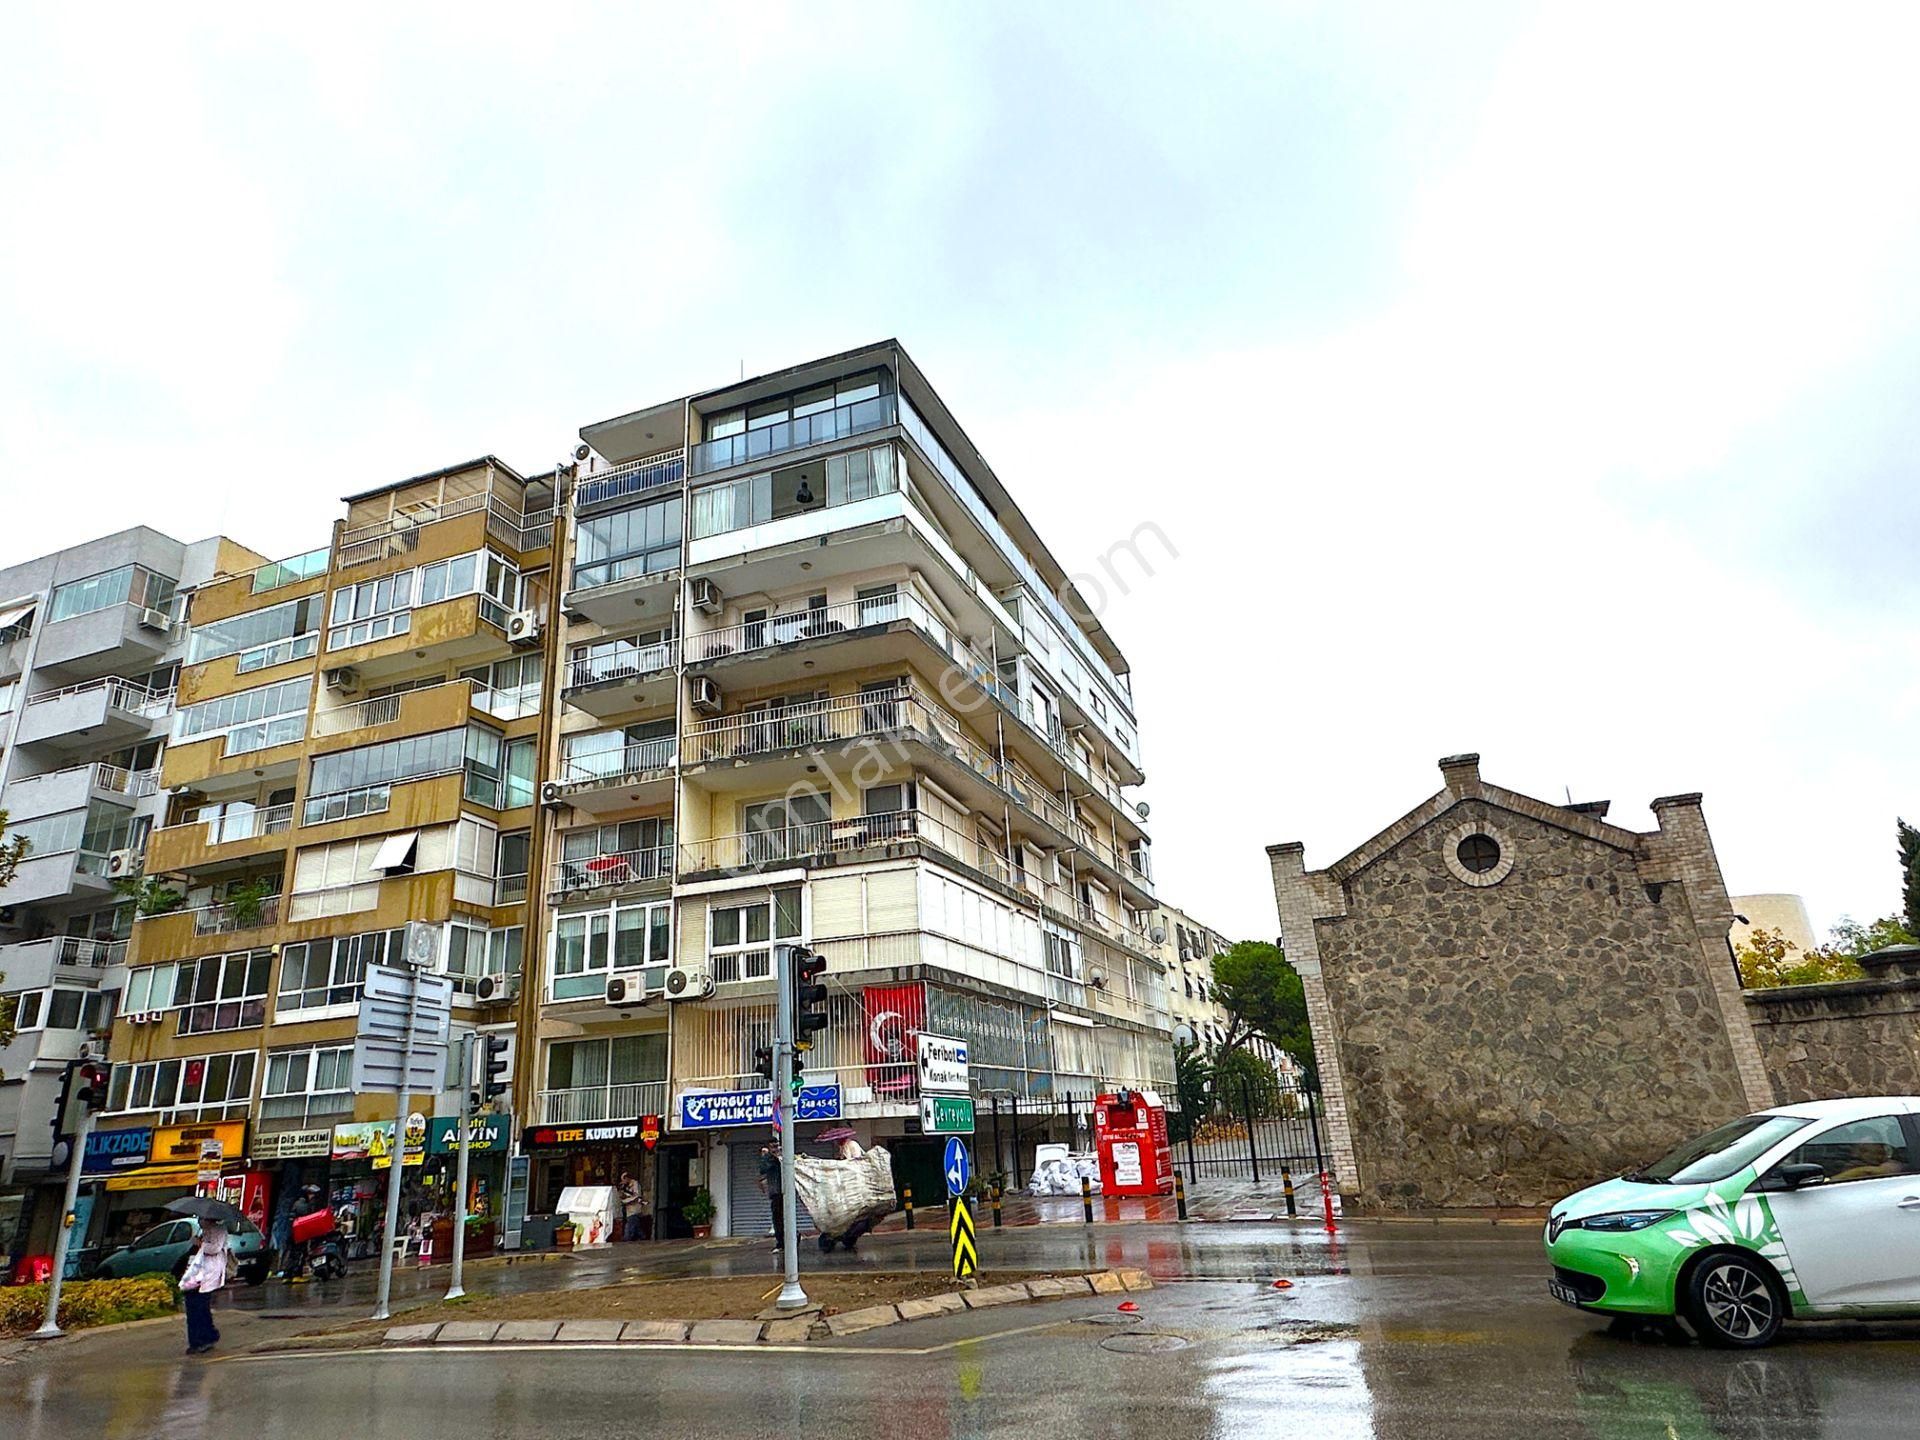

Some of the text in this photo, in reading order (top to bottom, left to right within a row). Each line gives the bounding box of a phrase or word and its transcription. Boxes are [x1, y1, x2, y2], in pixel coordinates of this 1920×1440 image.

[928, 1042, 957, 1063] Feribot
[929, 1069, 948, 1083] Konak
[706, 1091, 774, 1109] TURGUT REİ
[801, 1099, 838, 1109] 248 45 45
[934, 1101, 972, 1127] Çevreyolu
[281, 1132, 329, 1144] DİŞ HEKİMİ
